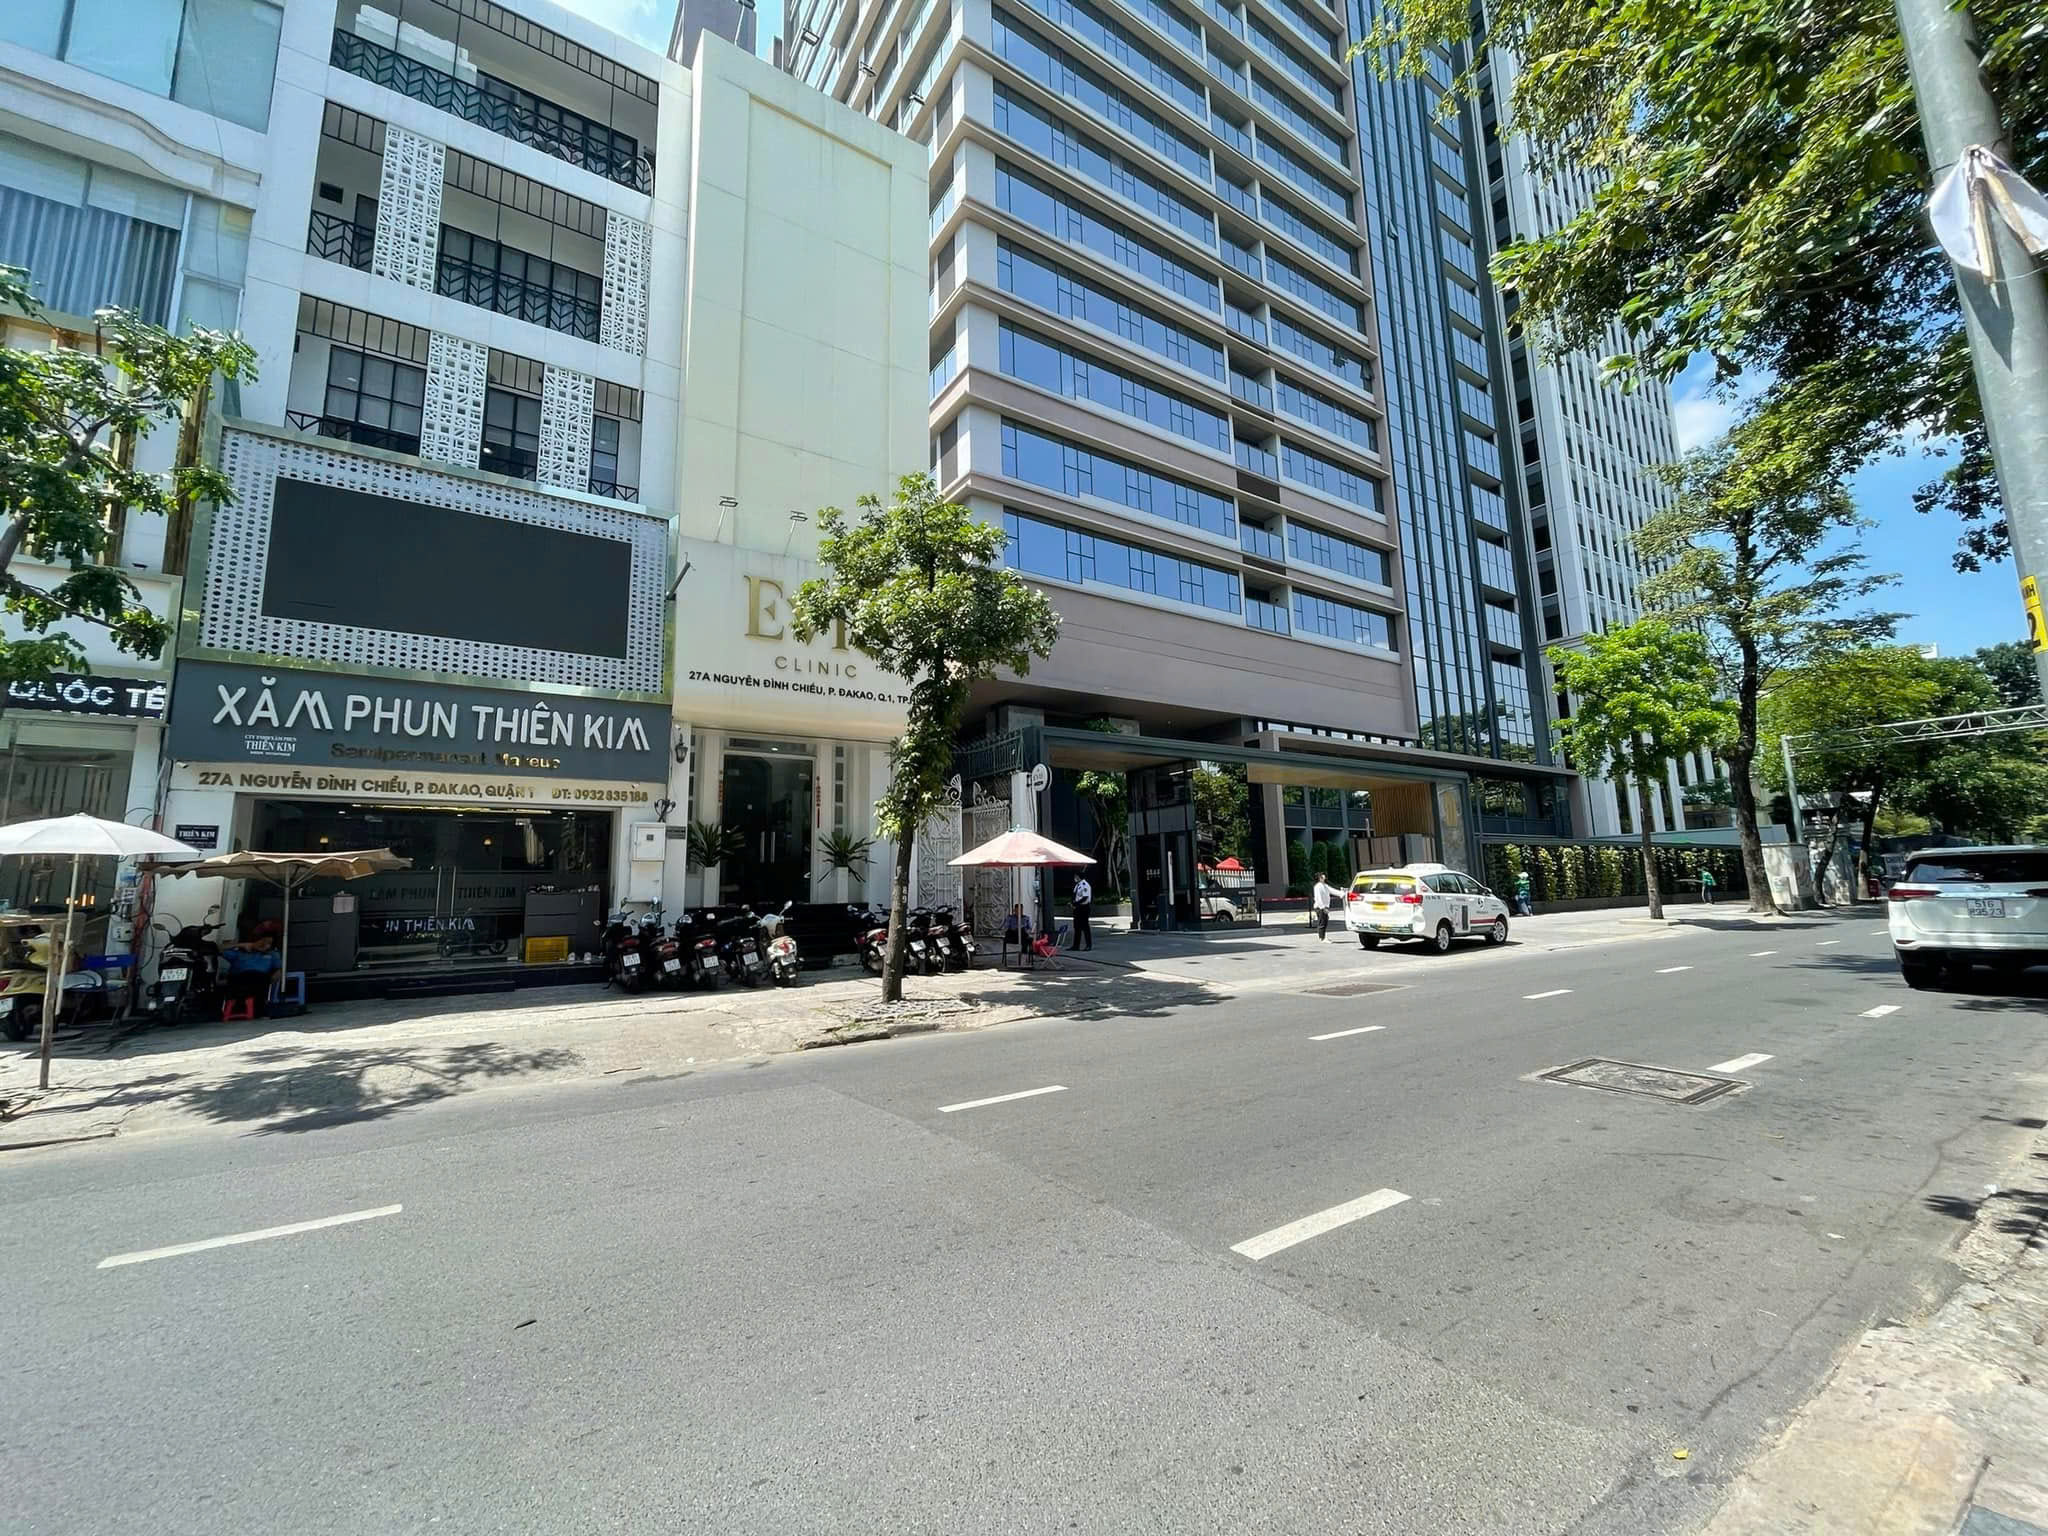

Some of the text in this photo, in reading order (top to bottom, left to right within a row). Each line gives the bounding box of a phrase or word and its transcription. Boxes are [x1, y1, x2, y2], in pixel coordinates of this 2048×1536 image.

[774, 655, 858, 679] CLINIC
[688, 670, 711, 681] 27A
[763, 678, 789, 691] ĐÌNH
[828, 687, 837, 697] P.
[838, 688, 877, 701] ĐAKAO,
[211, 676, 650, 751] XĂM PHUN THIÊN KIM
[245, 739, 296, 753] THIÊN KIM
[198, 771, 234, 786] 27A
[240, 770, 314, 790] NGUYỄN
[317, 775, 356, 793] ĐÌNH
[414, 784, 424, 795] P.
[427, 782, 483, 798] ĐAKAO,
[485, 783, 525, 800] QUẬN
